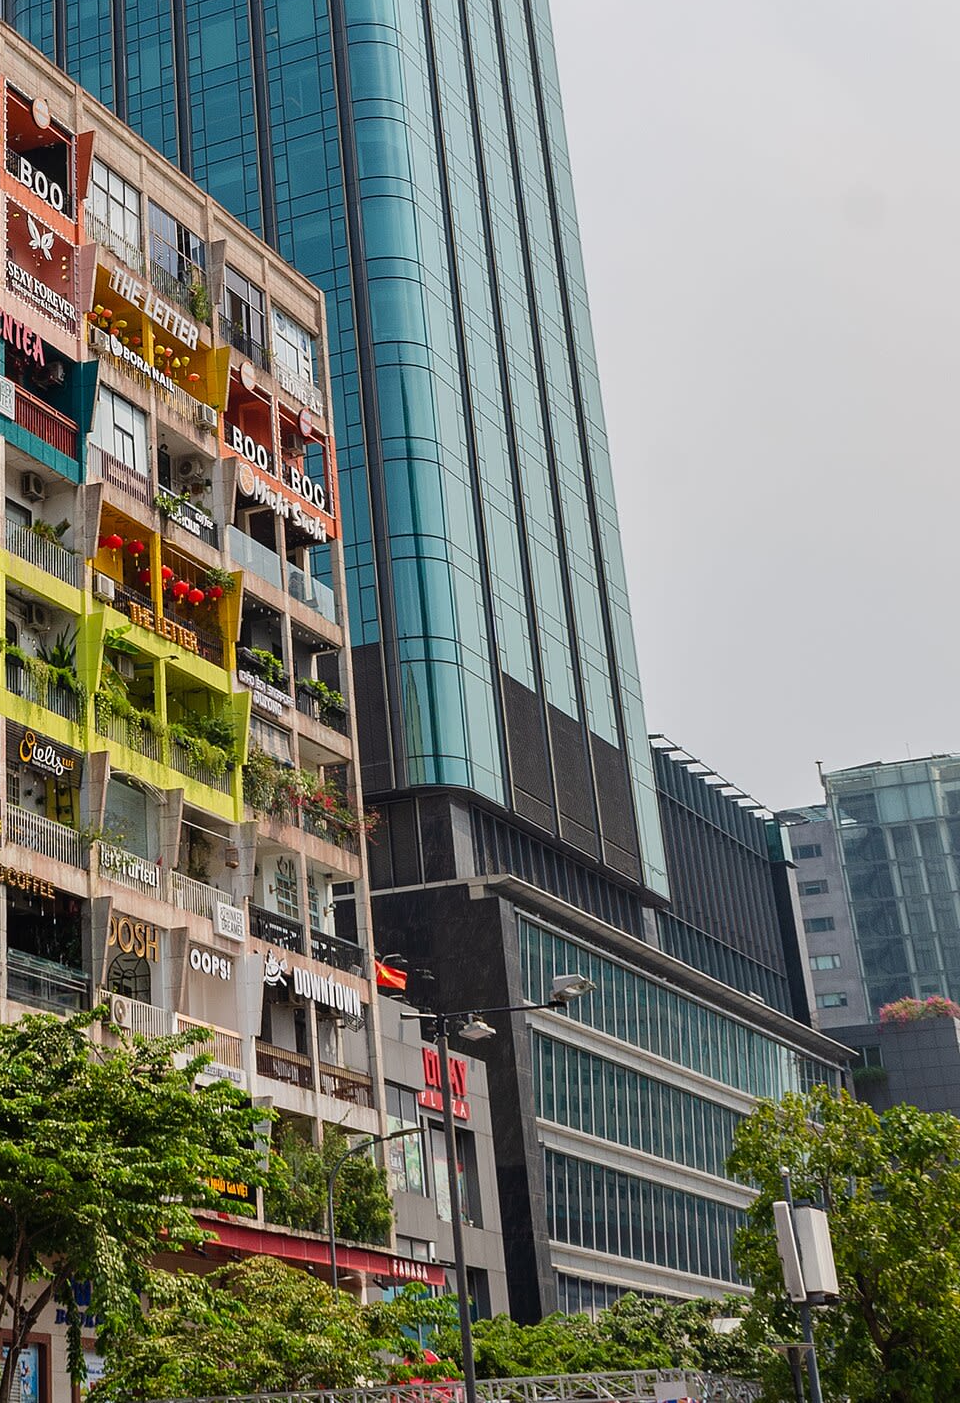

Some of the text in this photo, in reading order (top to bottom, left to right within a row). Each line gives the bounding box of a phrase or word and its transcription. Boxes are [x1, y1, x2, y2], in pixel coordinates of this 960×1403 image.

[20, 157, 63, 211] BOO
[7, 261, 77, 322] SEXY FOREVER
[110, 265, 199, 351] THE LETTER
[123, 346, 175, 394] BORA NAIL
[233, 425, 268, 471] BOO
[292, 501, 327, 543] Sushi
[129, 600, 199, 655] THE LETTER
[7, 867, 56, 899] COFFEE
[190, 948, 231, 980] OOPS!
[421, 1091, 467, 1118] PLZA
[393, 1258, 428, 1281] FAHASA
